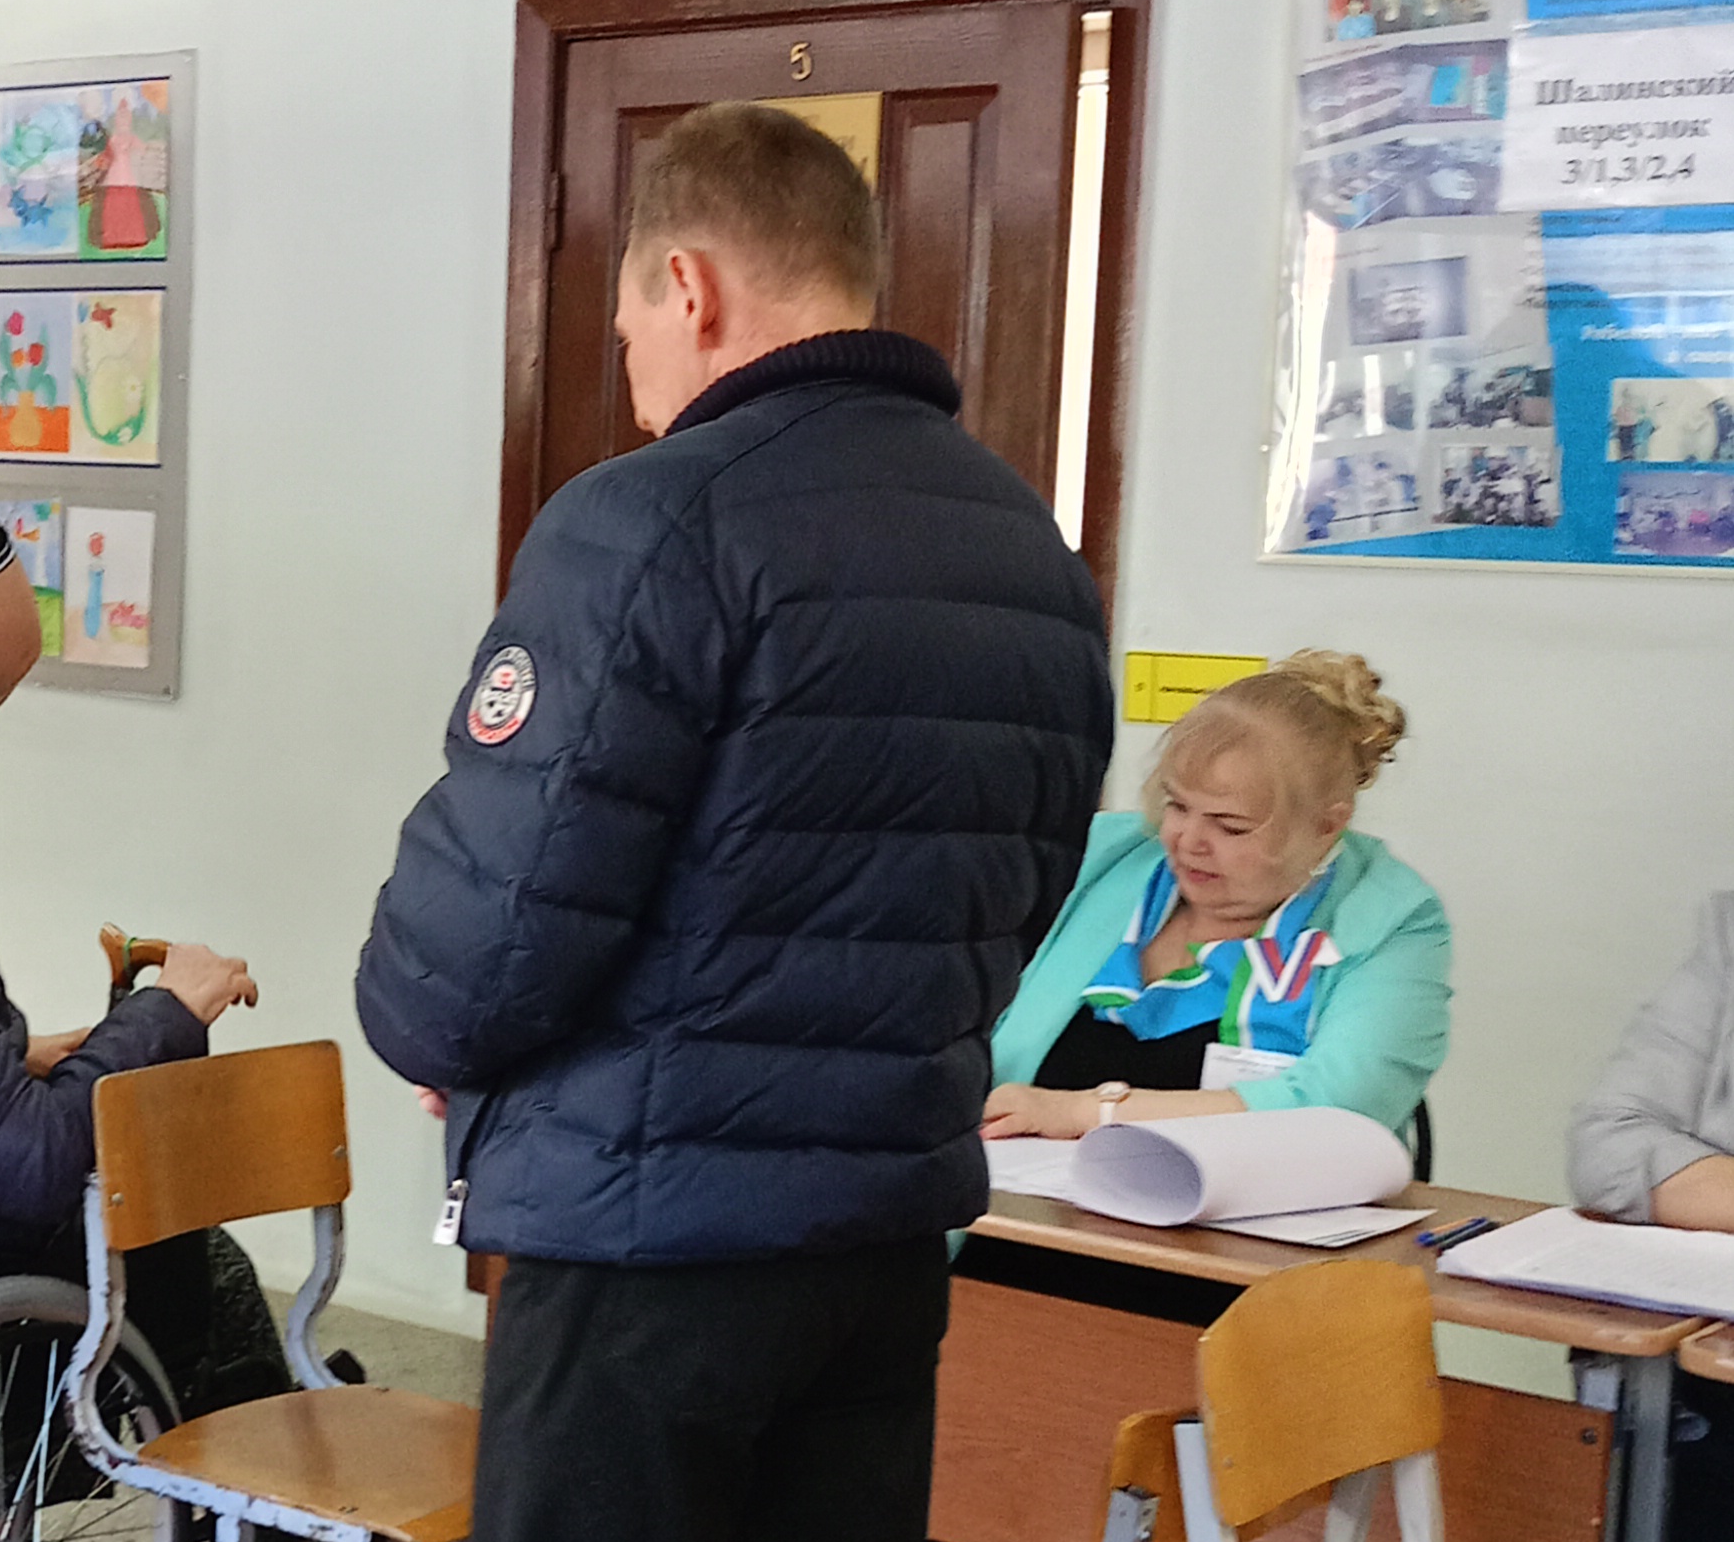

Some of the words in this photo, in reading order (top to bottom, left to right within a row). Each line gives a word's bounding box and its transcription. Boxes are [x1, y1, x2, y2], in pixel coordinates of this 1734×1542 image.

[790, 41, 812, 81] 5
[1534, 68, 1734, 106] Шалинский
[1556, 118, 1712, 150] переулок
[1561, 152, 1696, 187] 3/1,3/2,4
